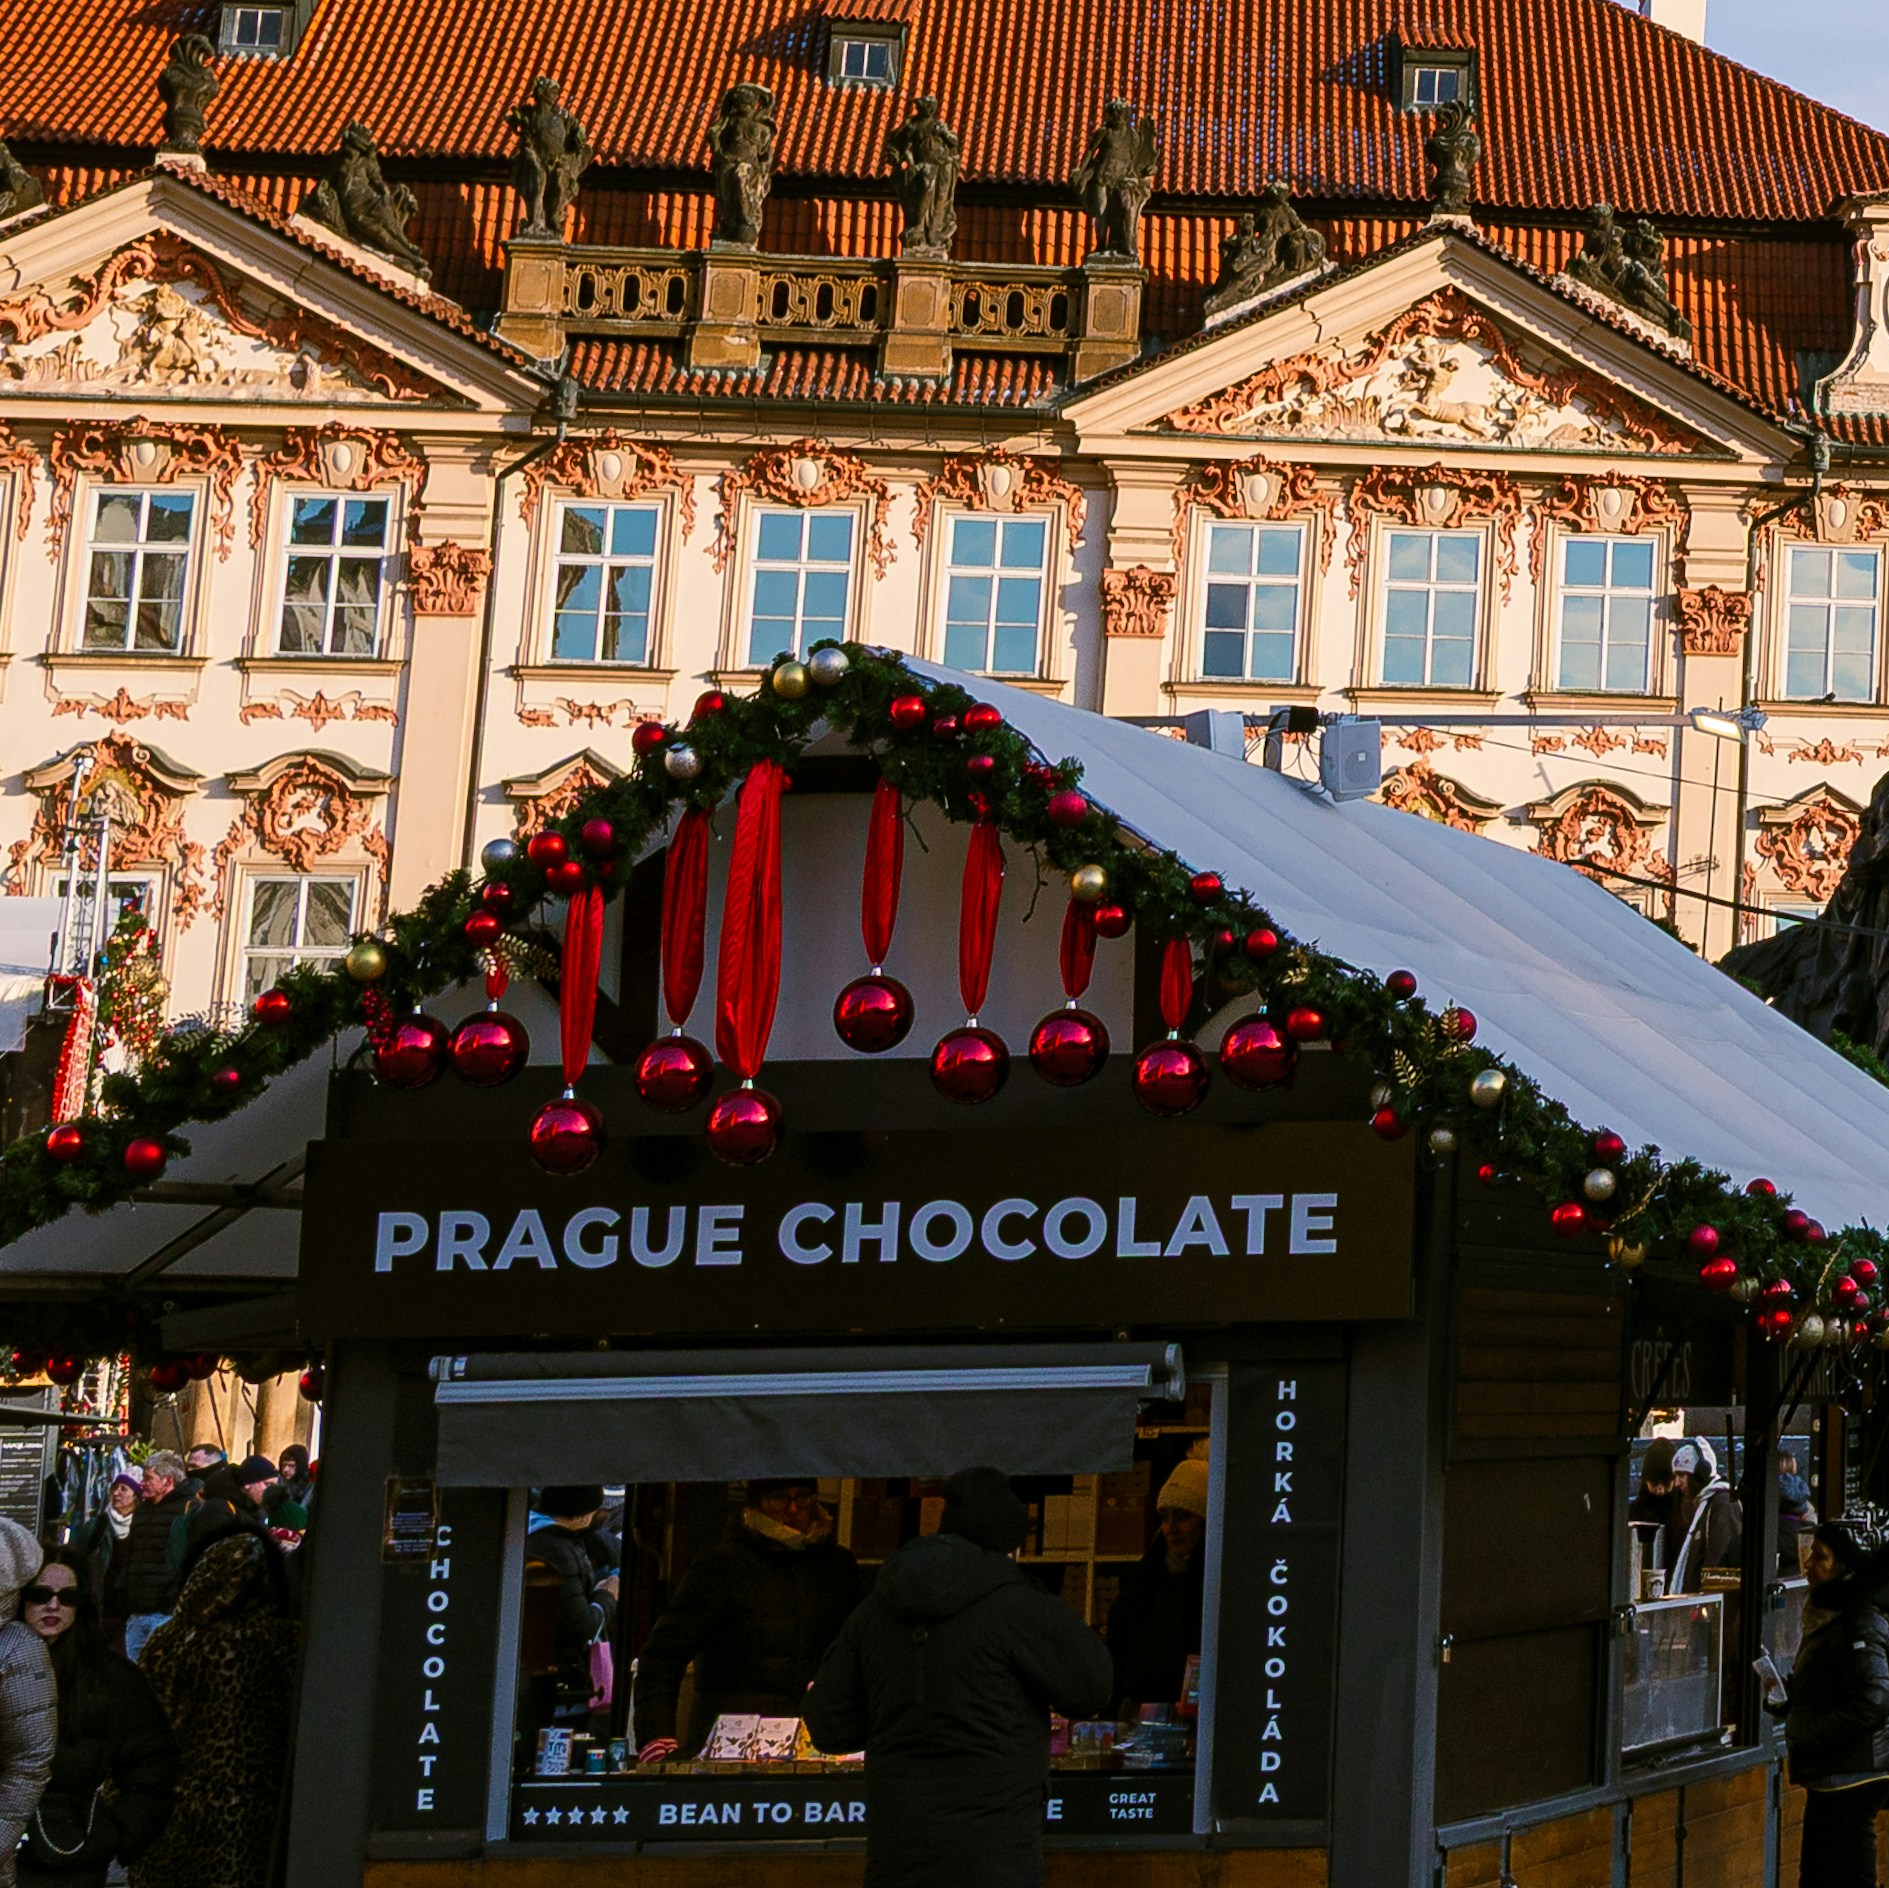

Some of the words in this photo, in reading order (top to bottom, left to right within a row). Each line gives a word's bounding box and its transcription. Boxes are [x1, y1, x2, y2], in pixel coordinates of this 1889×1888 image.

[374, 1204, 745, 1272] PRAGUE
[777, 1192, 1338, 1265] CHOCOLATE
[1270, 1380, 1297, 1523] HORKÁ
[416, 1525, 452, 1810] CHOCOLATE
[1258, 1559, 1289, 1803] ČOKOLÁDA
[658, 1802, 742, 1825] BEAN
[752, 1802, 794, 1824] TO
[804, 1800, 867, 1824] BAR
[1109, 1792, 1157, 1805] GREAT
[1109, 1806, 1154, 1820] TASTE
